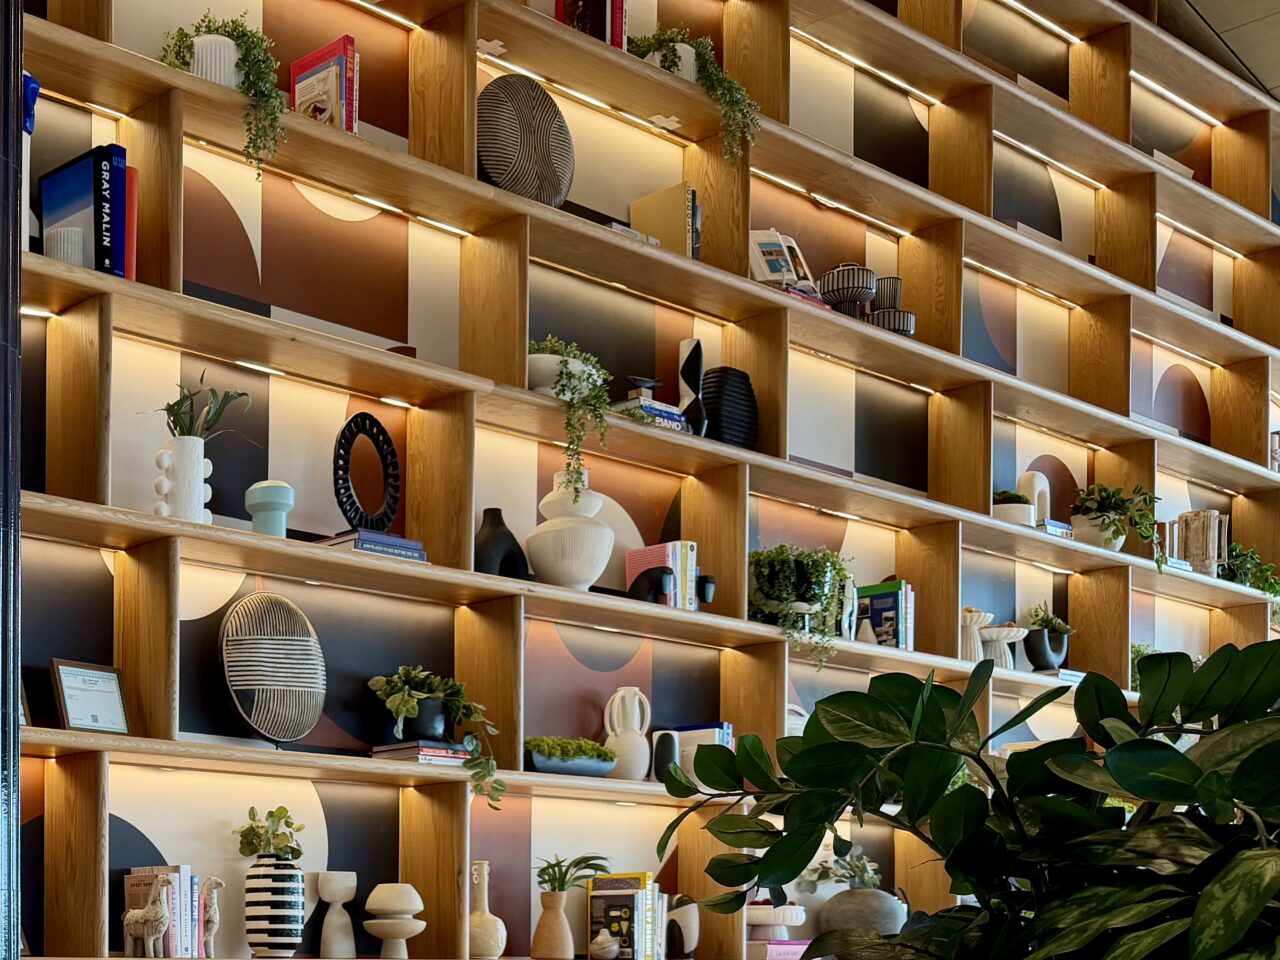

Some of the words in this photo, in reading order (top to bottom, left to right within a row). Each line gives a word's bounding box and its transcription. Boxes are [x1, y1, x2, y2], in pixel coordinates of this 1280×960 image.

[101, 161, 110, 198] GRAY
[102, 203, 111, 247] MALIN
[655, 416, 682, 431] PIANO
